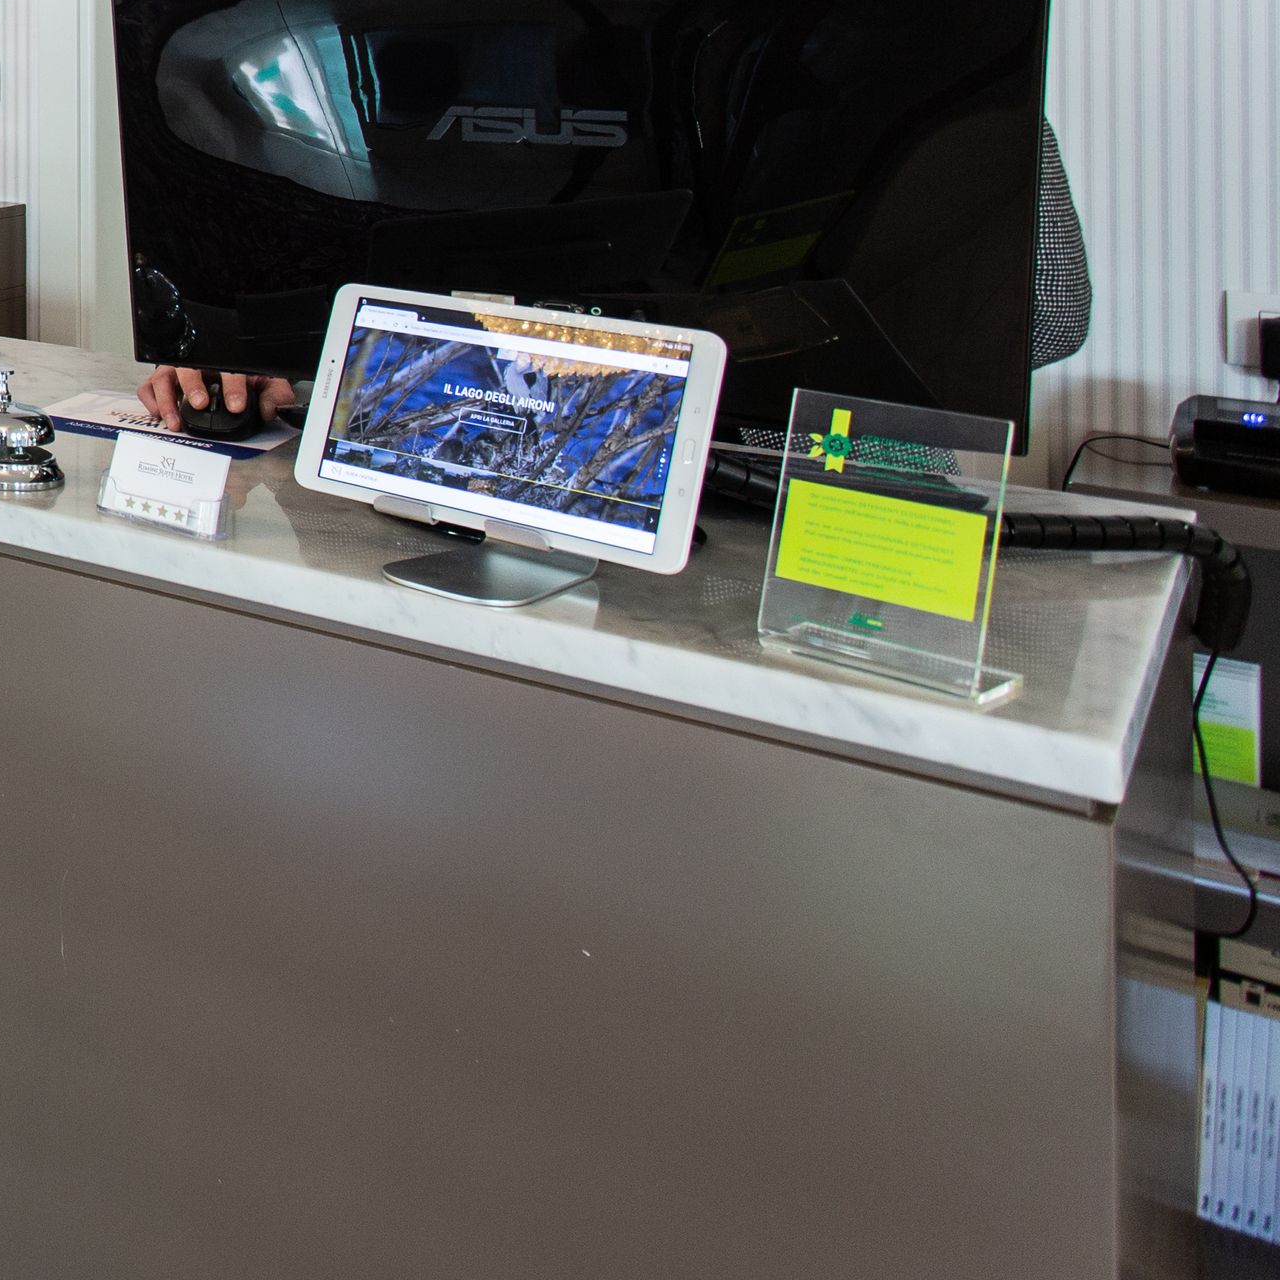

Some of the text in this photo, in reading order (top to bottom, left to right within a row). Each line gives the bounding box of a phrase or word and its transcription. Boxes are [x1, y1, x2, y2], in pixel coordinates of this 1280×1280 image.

[426, 105, 628, 148] ASUS
[443, 383, 556, 413] IL LAGO DEGLI AIRONI
[482, 415, 490, 423] LA
[490, 416, 515, 427] GALLERIA
